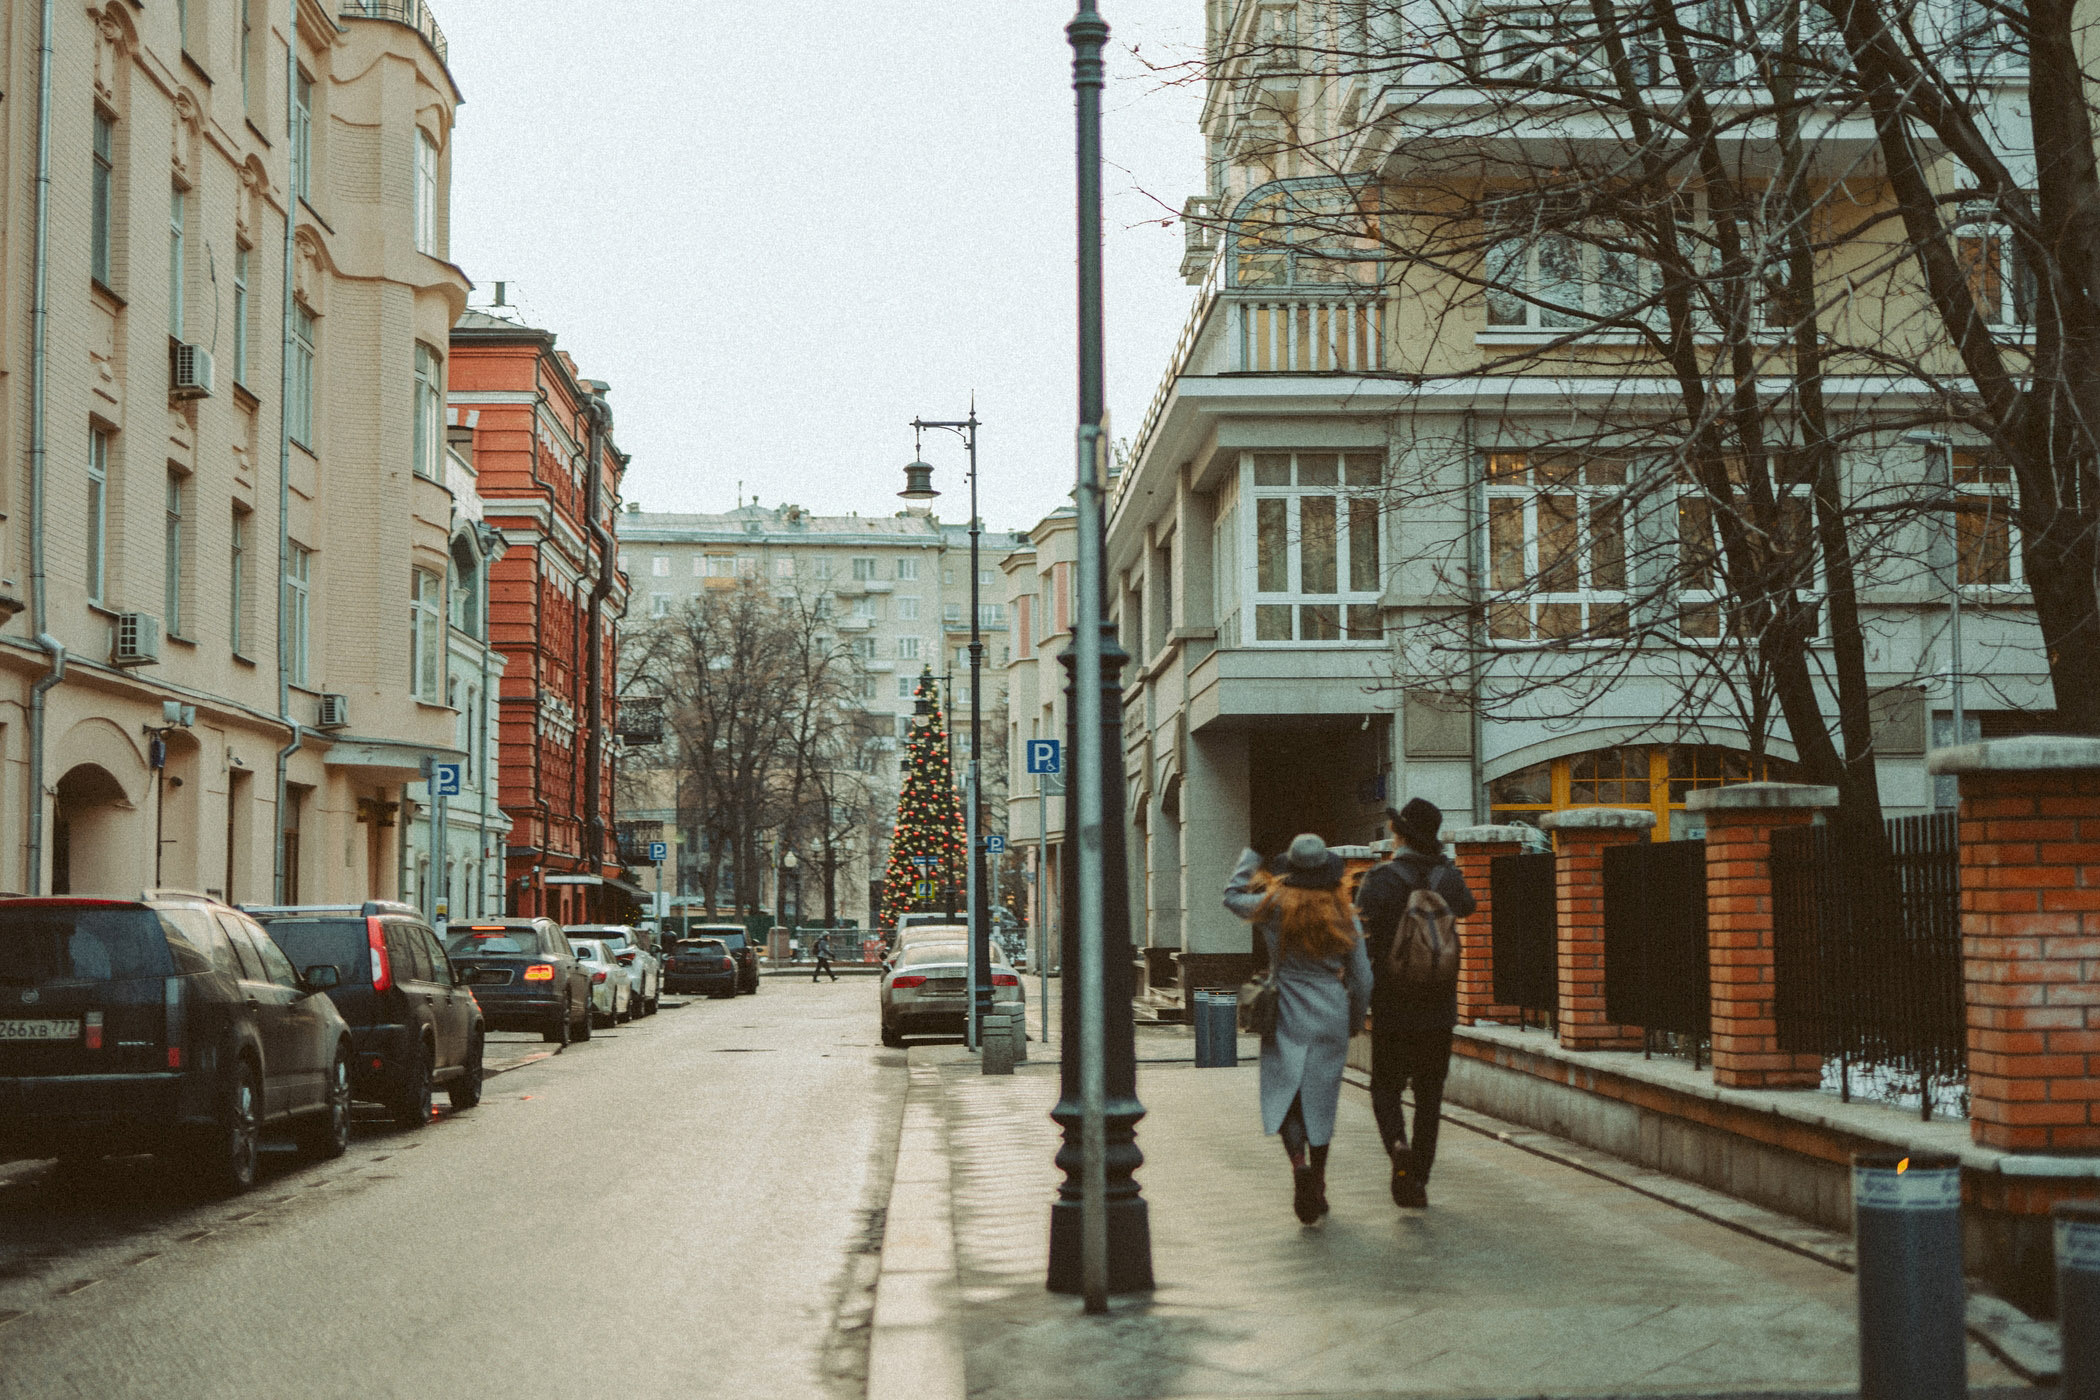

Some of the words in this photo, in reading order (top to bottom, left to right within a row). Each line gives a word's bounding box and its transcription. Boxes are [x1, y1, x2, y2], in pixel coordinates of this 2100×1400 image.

[1034, 743, 1053, 770] P
[437, 767, 455, 792] P
[654, 844, 665, 858] P
[991, 838, 1001, 852] P
